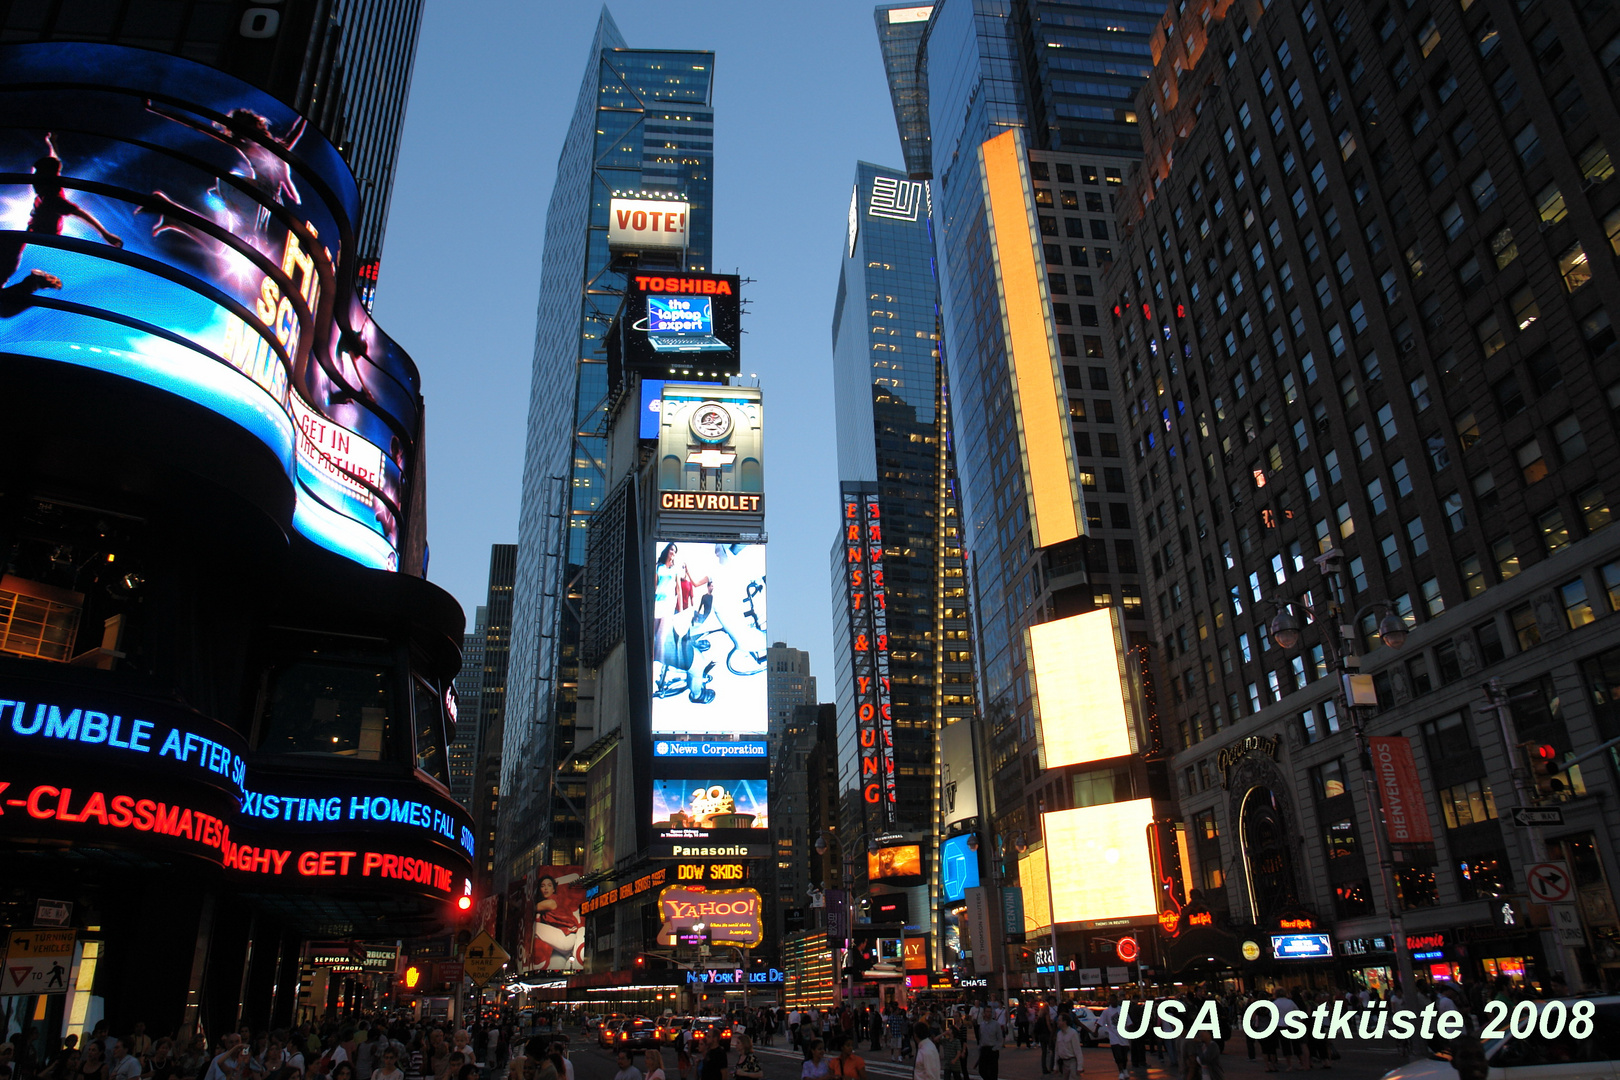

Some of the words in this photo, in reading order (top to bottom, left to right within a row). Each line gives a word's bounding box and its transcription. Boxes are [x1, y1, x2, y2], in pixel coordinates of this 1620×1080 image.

[616, 209, 685, 233] VOTE!
[635, 276, 732, 295] TOSHIBA
[668, 299, 691, 310] the
[658, 309, 702, 321] laptop
[658, 320, 703, 331] expert
[301, 414, 327, 443] GET
[331, 430, 350, 455] IN
[662, 493, 760, 511] CHEVROLET
[847, 503, 864, 609] ERNST
[854, 634, 869, 651] &
[0, 699, 154, 753] TUMBLE
[159, 728, 232, 778] AFTER
[858, 677, 880, 803] YOUNG
[670, 743, 698, 755] News
[702, 743, 765, 757] Corporation
[1217, 733, 1280, 791] Paramount
[1377, 743, 1409, 839] BIENVENIDOS
[349, 797, 431, 829] HOMES
[433, 809, 455, 840] FALL
[1520, 812, 1536, 822] ONE
[1541, 811, 1557, 821] WAY
[673, 845, 748, 856] Panasonic
[297, 851, 357, 877] GET
[362, 852, 433, 886] PRISON
[678, 864, 705, 880] DOW
[710, 864, 743, 880] SKIDS
[665, 899, 755, 919] YAHOO!
[1280, 919, 1296, 928] Hard
[1296, 919, 1312, 929] Rock
[1560, 911, 1573, 923] NO
[34, 932, 74, 943] TURNING
[1559, 928, 1581, 941] TURNS
[33, 944, 70, 953] VEHICLES
[32, 972, 43, 980] TO
[708, 969, 734, 984] YORK
[735, 969, 767, 983] PLICE
[961, 979, 987, 987] CHASE
